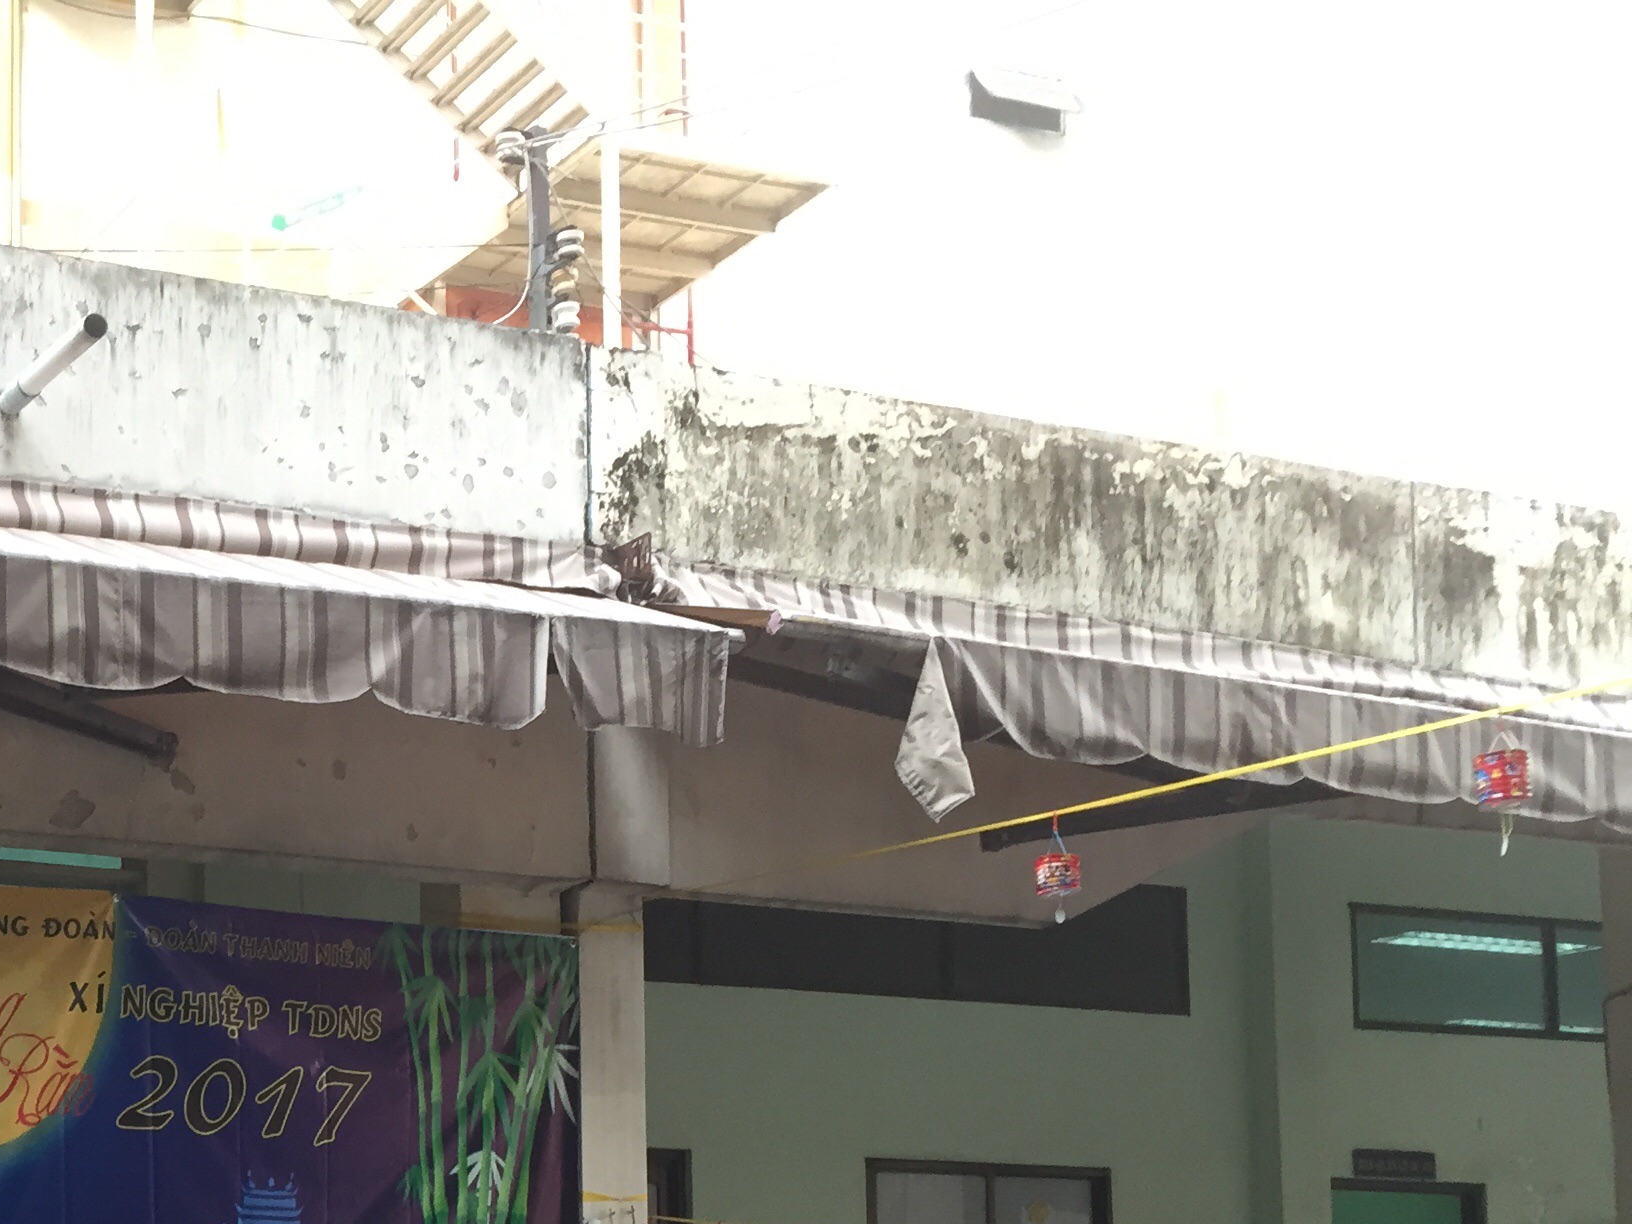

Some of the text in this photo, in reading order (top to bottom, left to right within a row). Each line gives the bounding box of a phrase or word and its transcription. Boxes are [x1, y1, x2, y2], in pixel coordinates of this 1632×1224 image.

[41, 911, 116, 941] ĐOÀN
[146, 919, 217, 955] ĐOÀN
[223, 931, 309, 964] THANH
[316, 938, 371, 971] NIÊN
[69, 970, 383, 1042] XÍ NGHIỆP TDNS
[116, 1054, 372, 1148] 2017
